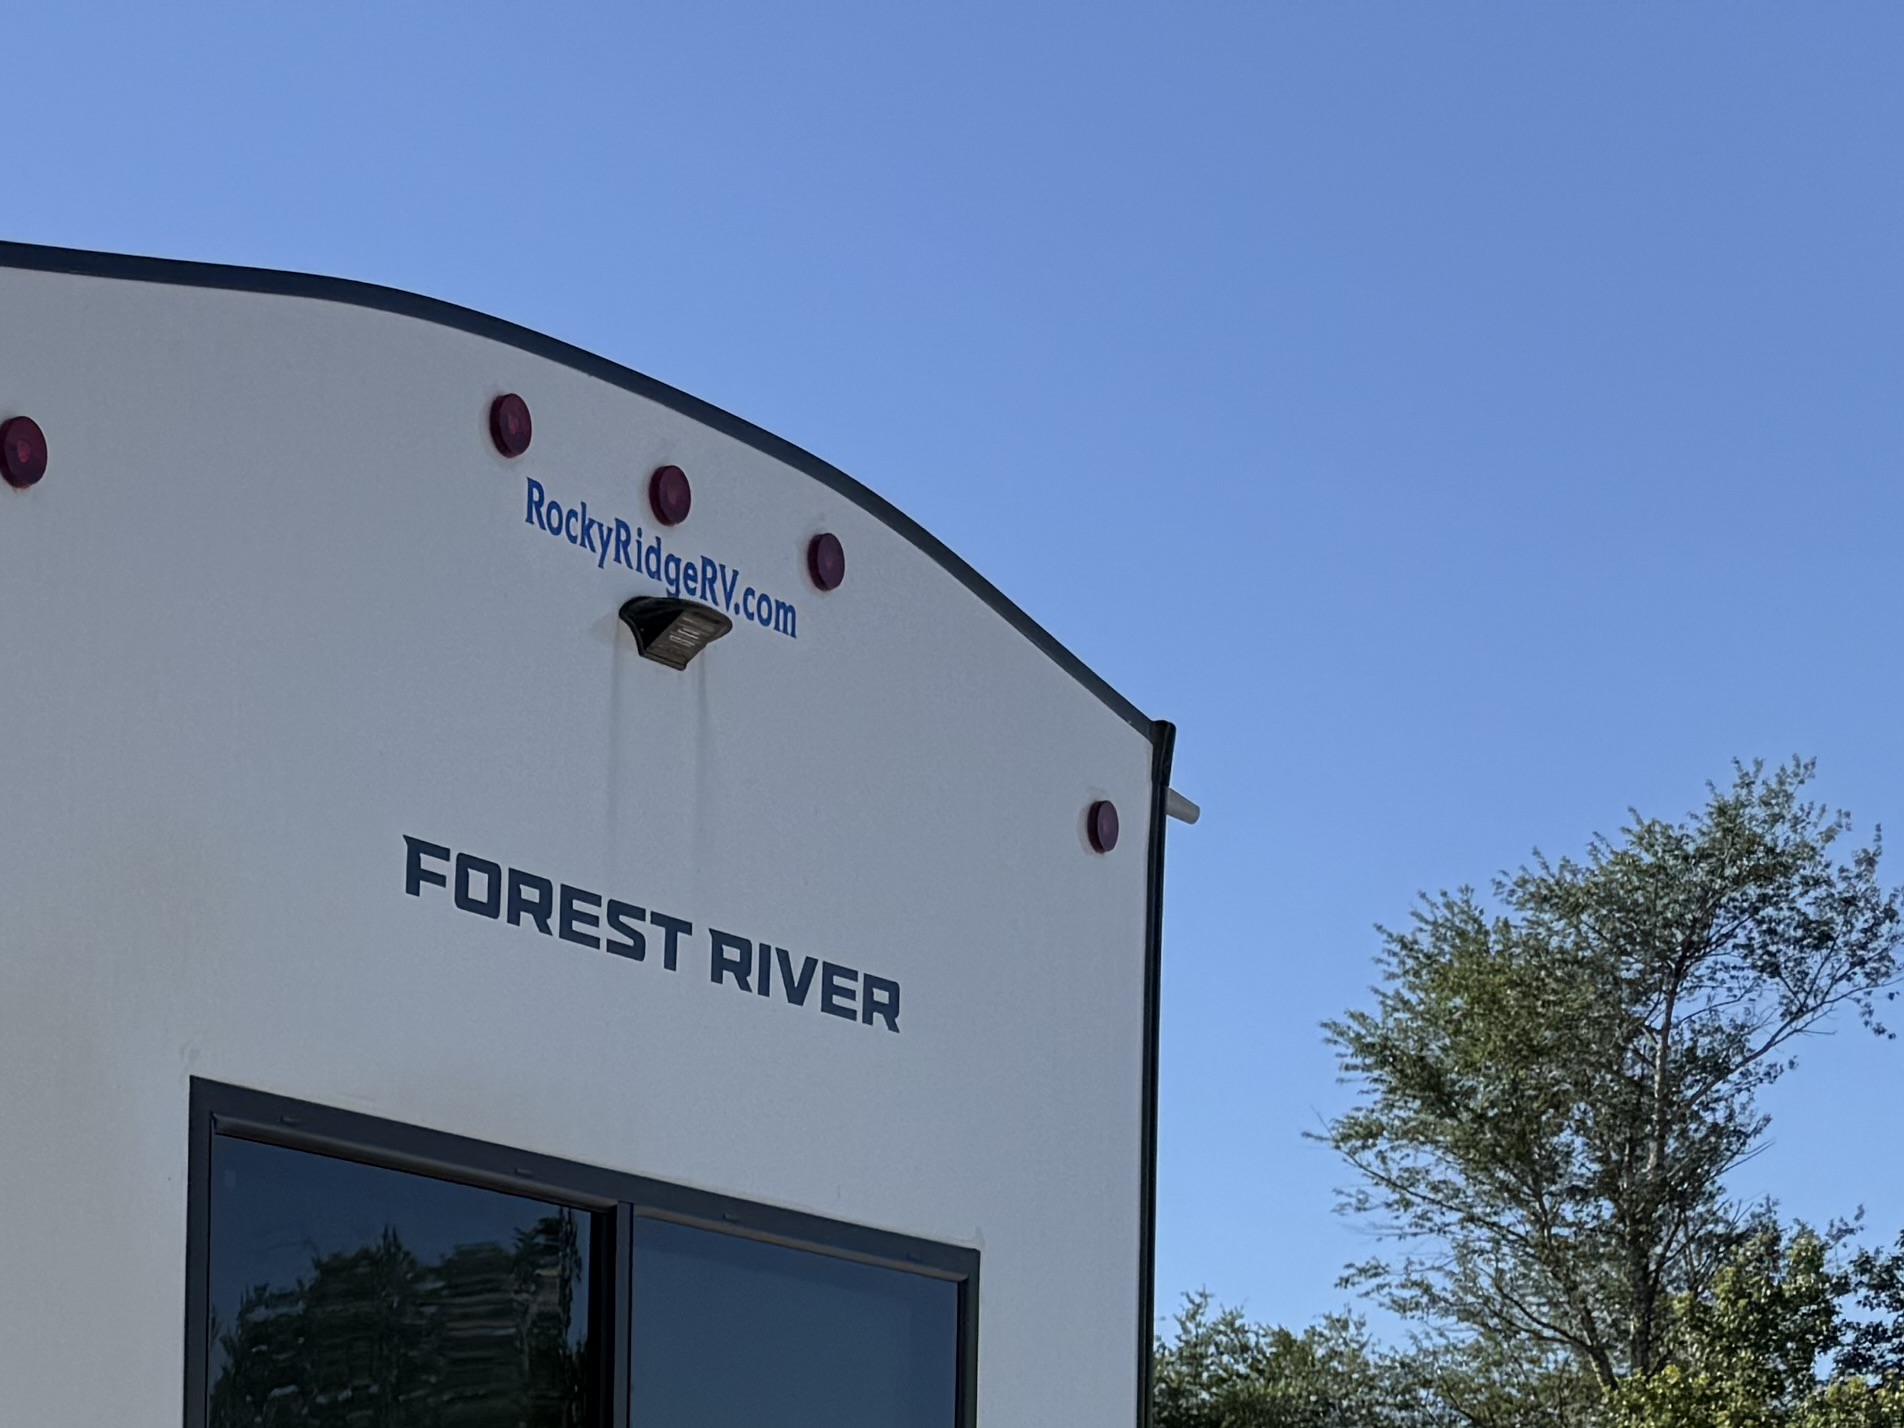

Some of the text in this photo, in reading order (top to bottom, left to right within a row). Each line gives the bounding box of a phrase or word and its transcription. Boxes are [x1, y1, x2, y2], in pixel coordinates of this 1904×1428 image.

[525, 476, 797, 639] RockyRidgeRV.com
[402, 834, 901, 1034] FOREST RIVER
